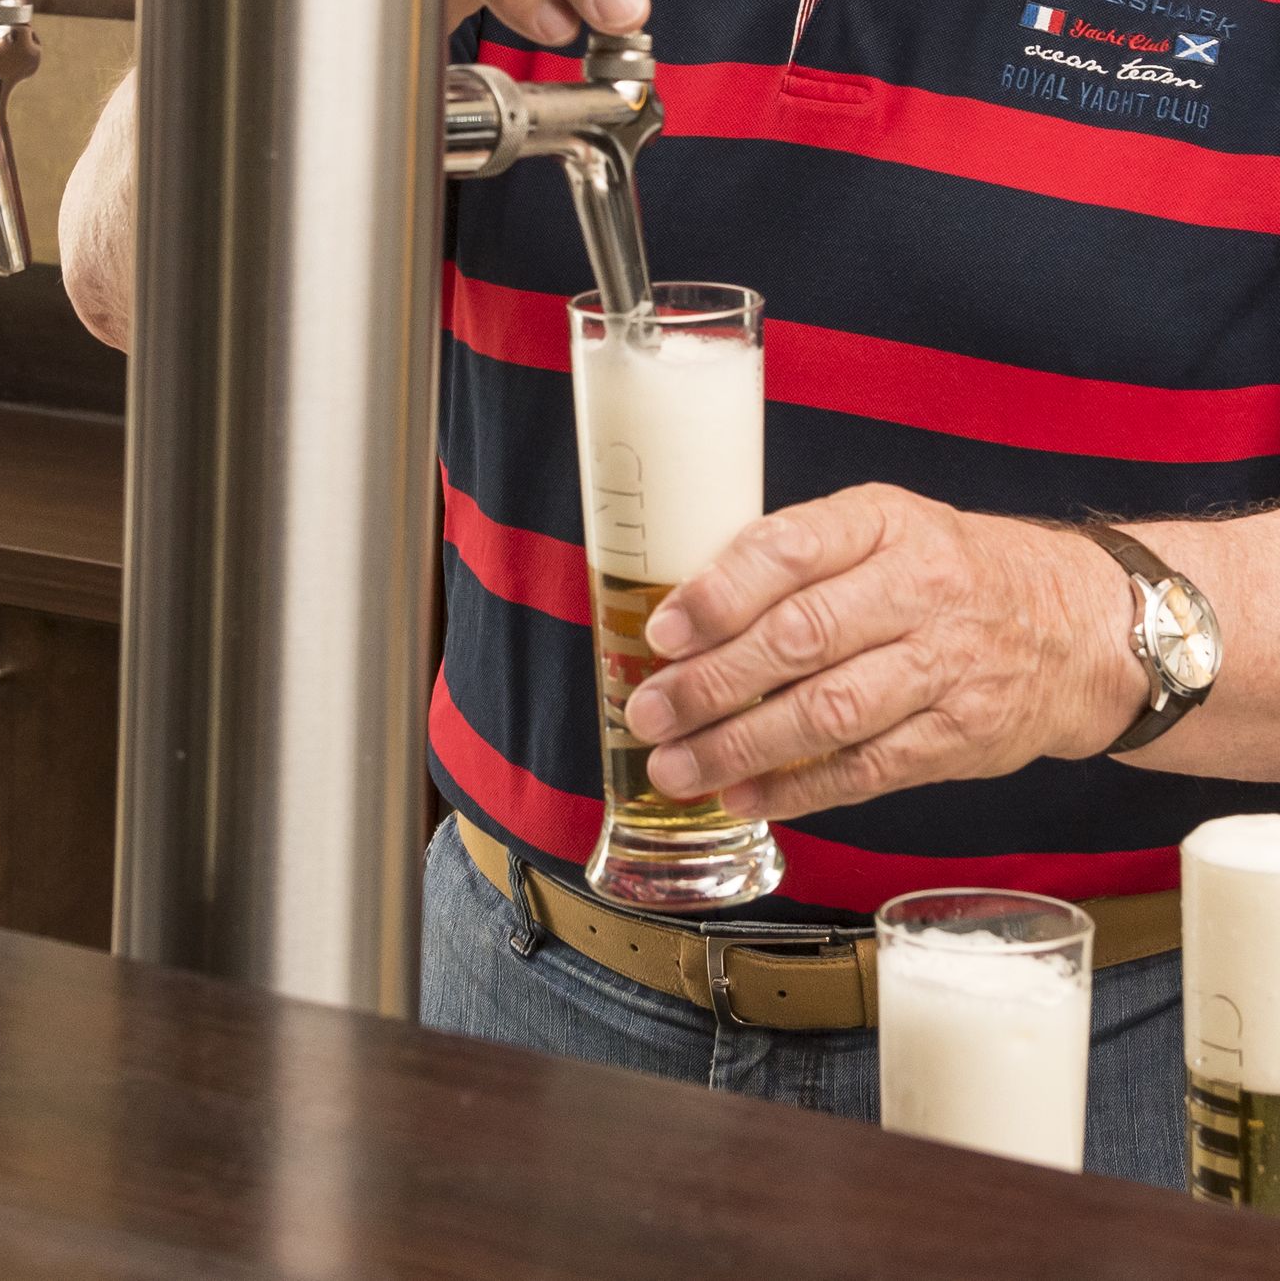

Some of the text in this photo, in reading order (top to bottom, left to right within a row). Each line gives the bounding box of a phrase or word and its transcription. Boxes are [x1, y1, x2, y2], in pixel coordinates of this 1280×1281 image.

[1070, 18, 1172, 53] Yacht Club
[1024, 44, 1202, 89] ocean team
[1001, 63, 1211, 129] ROYAL YACHT CLUB
